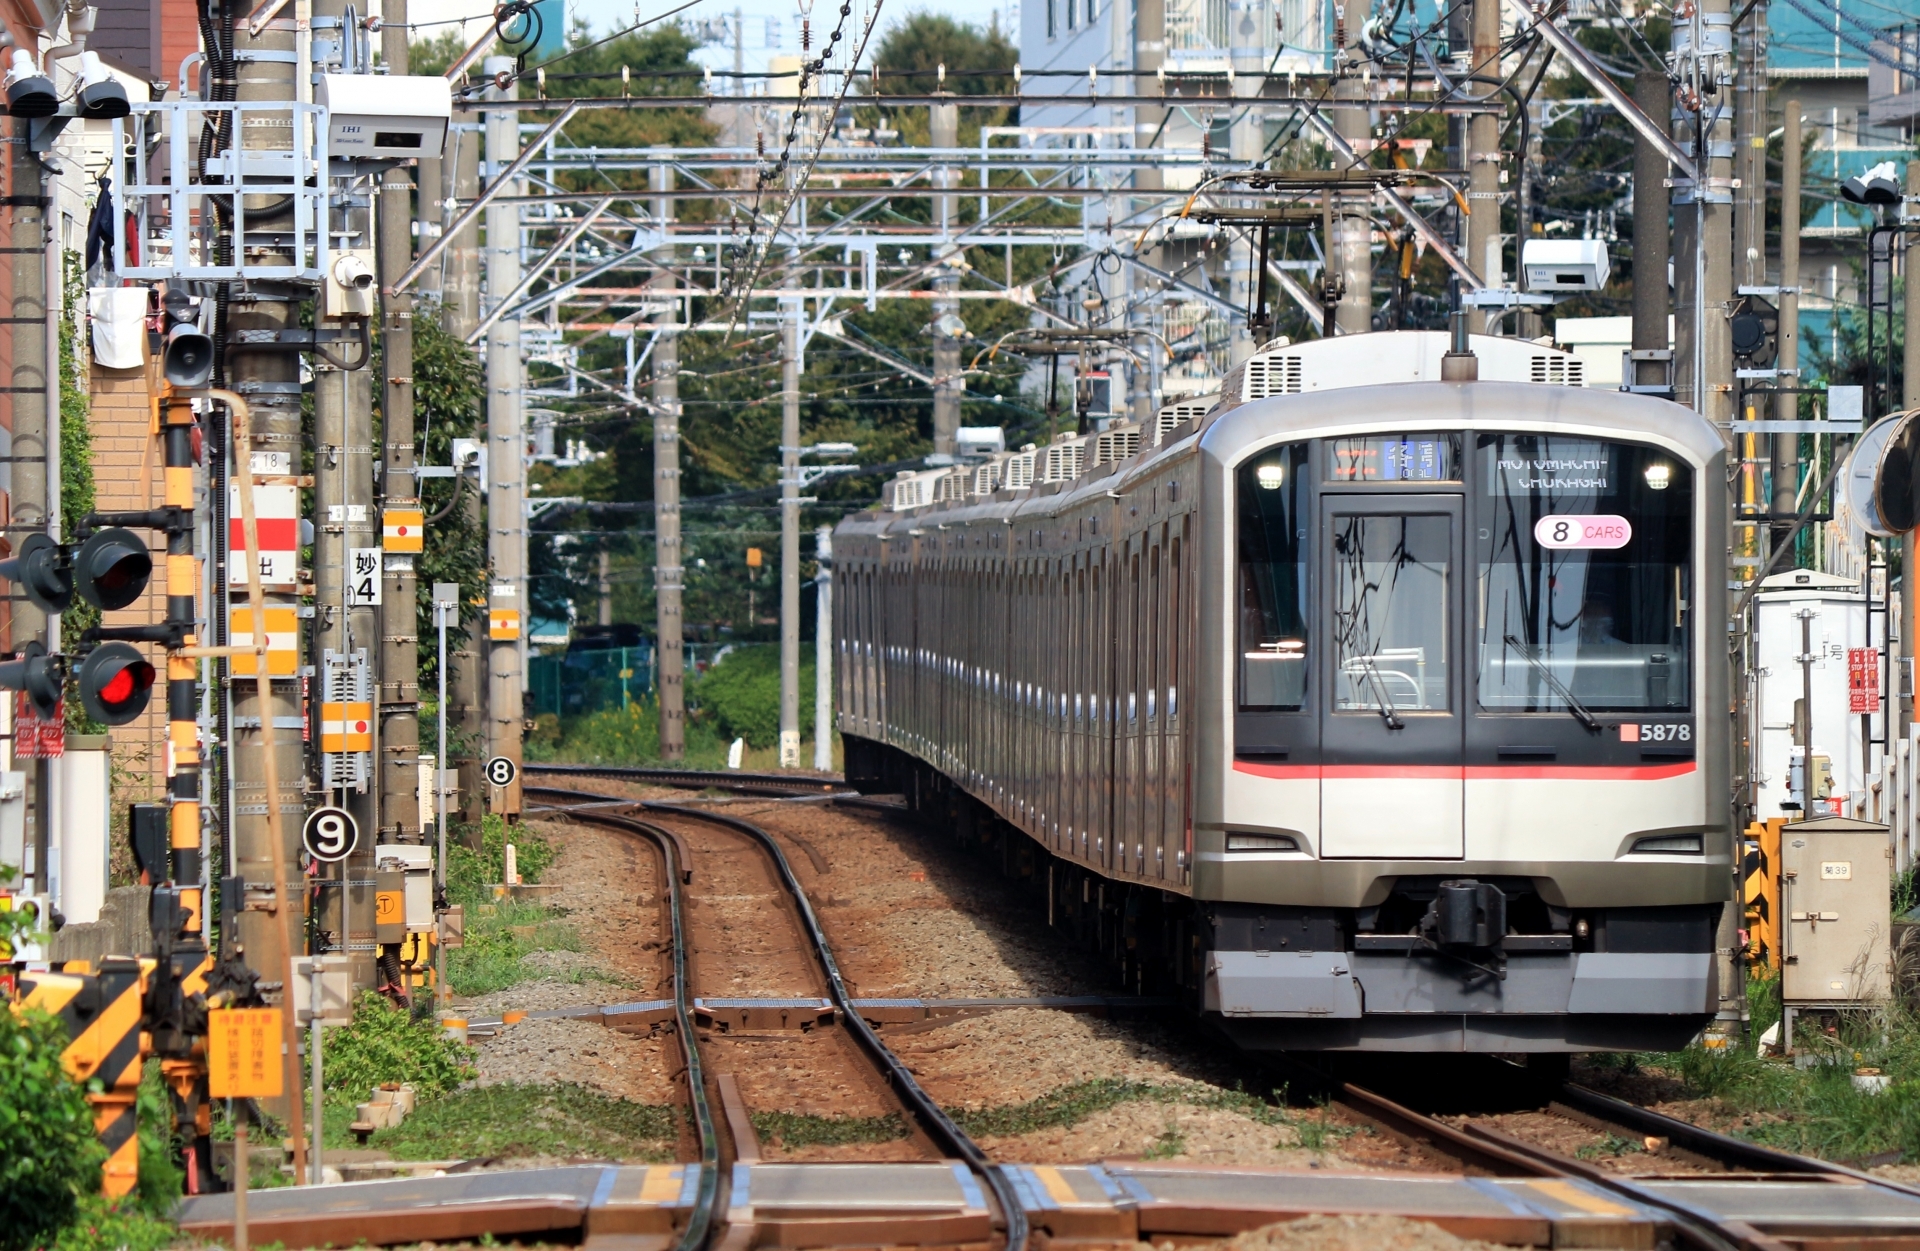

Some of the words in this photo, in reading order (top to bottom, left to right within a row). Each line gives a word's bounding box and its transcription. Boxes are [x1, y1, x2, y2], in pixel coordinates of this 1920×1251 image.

[264, 453, 278, 468] 18
[1552, 521, 1570, 543] 8
[1584, 526, 1624, 539] CARS
[1851, 663, 1864, 671] STOP
[1640, 724, 1691, 741] 5878
[492, 760, 509, 783] 8
[316, 814, 345, 854] 9
